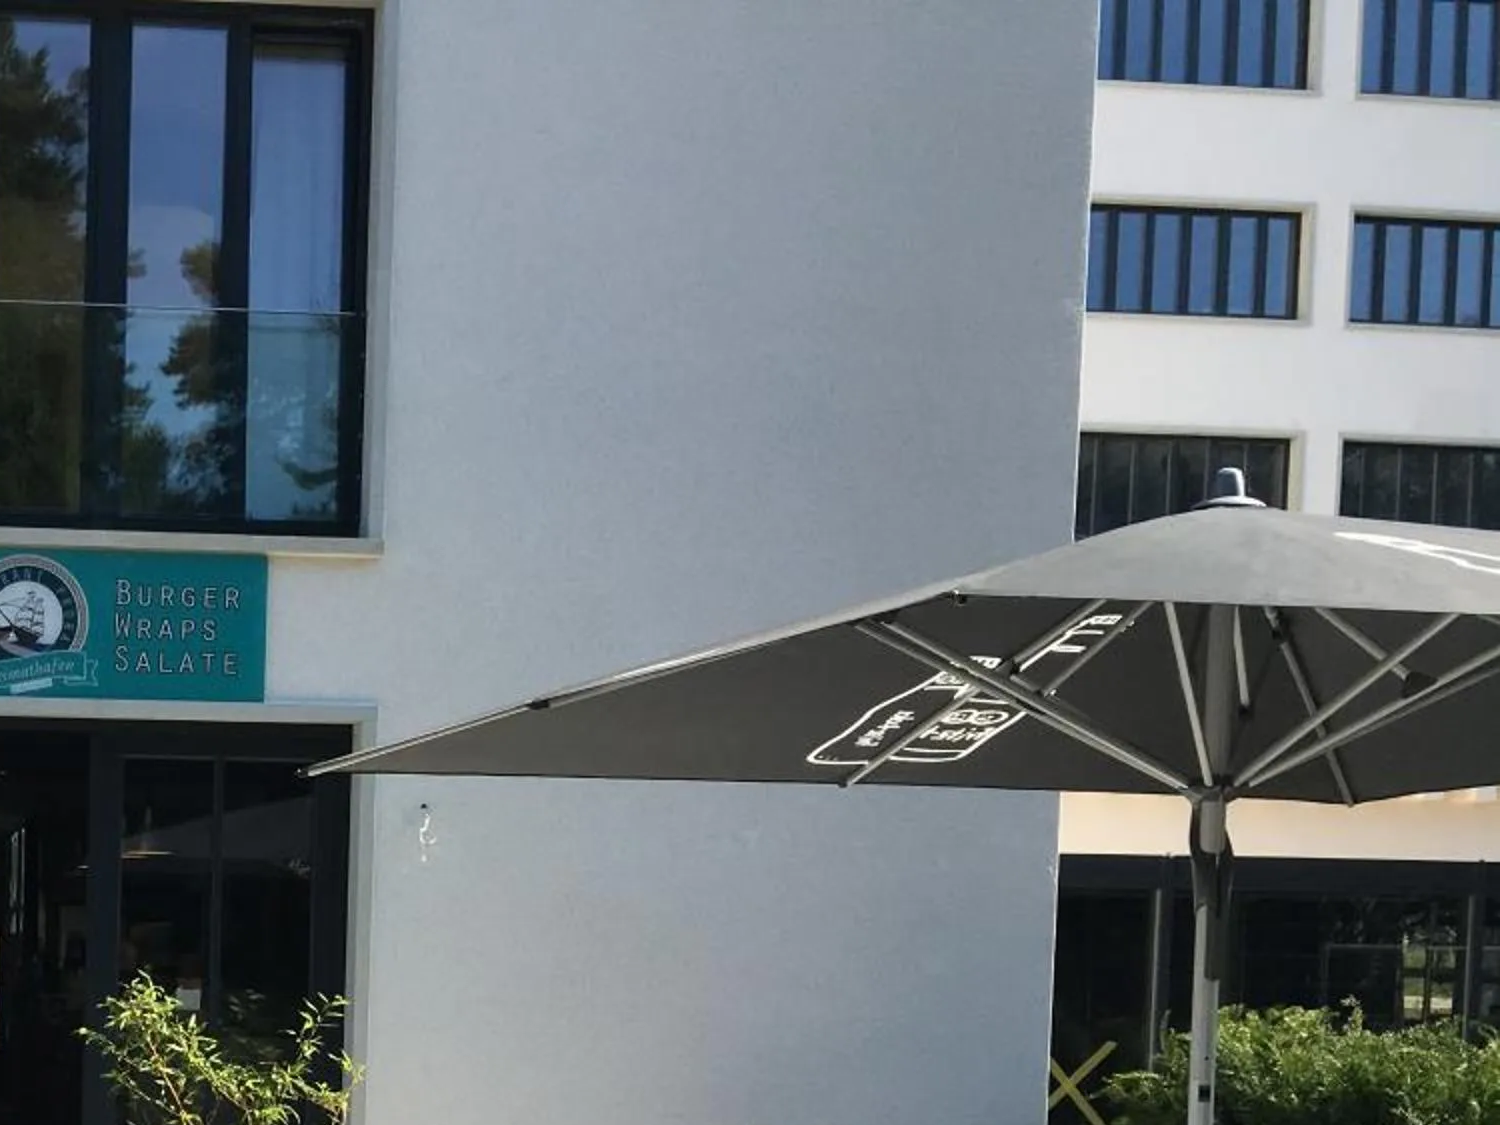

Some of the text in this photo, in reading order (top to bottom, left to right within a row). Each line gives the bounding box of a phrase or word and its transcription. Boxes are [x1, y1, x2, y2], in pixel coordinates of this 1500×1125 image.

[116, 579, 239, 609] BURGER
[115, 612, 216, 641] WRAPS
[115, 645, 237, 675] SALATE
